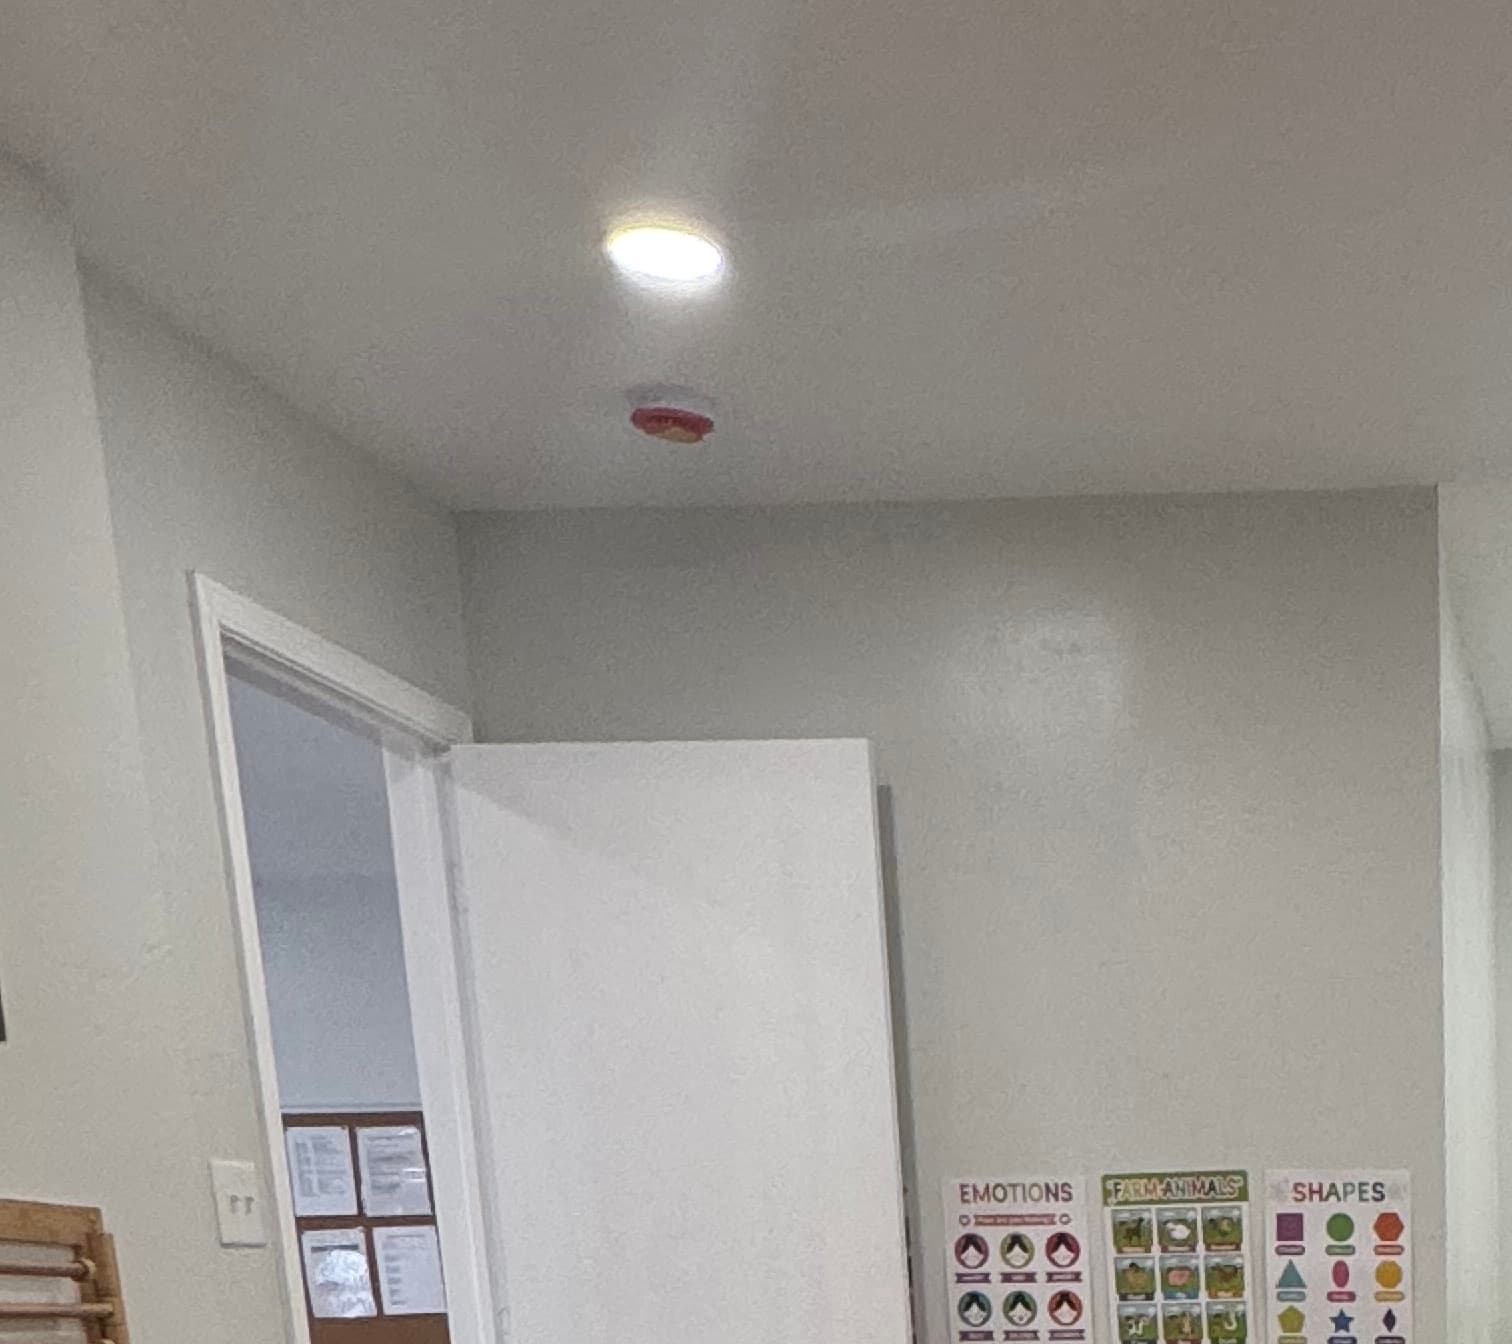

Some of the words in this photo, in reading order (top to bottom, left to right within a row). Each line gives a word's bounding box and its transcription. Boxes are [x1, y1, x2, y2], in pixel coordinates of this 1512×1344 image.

[958, 1182, 1073, 1203] EMOTIONS
[1112, 1179, 1160, 1199] FARM
[1161, 1176, 1238, 1198] ANIMALS
[1292, 1182, 1386, 1203] SHAPES
